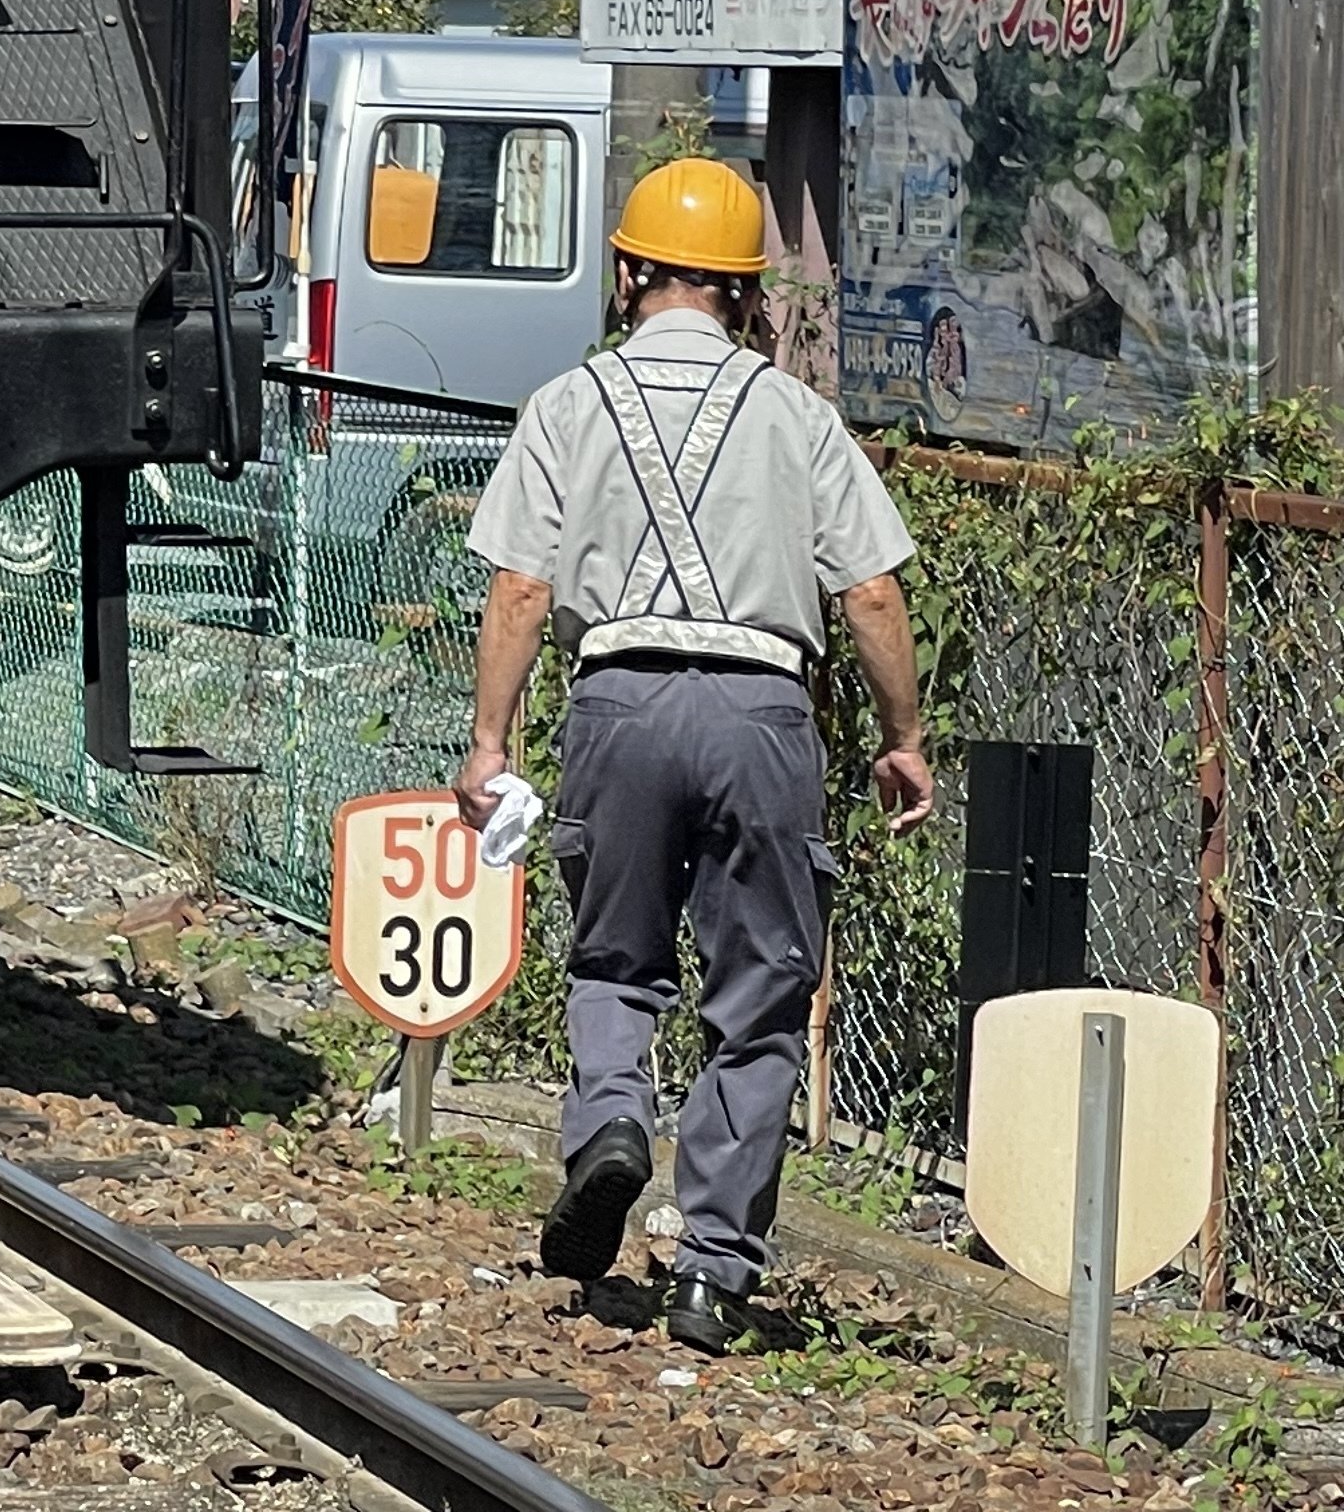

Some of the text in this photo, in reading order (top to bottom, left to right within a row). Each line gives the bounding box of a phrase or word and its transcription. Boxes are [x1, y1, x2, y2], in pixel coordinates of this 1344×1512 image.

[608, 2, 641, 36] FAX
[381, 817, 477, 900] 50
[379, 915, 473, 997] 30
